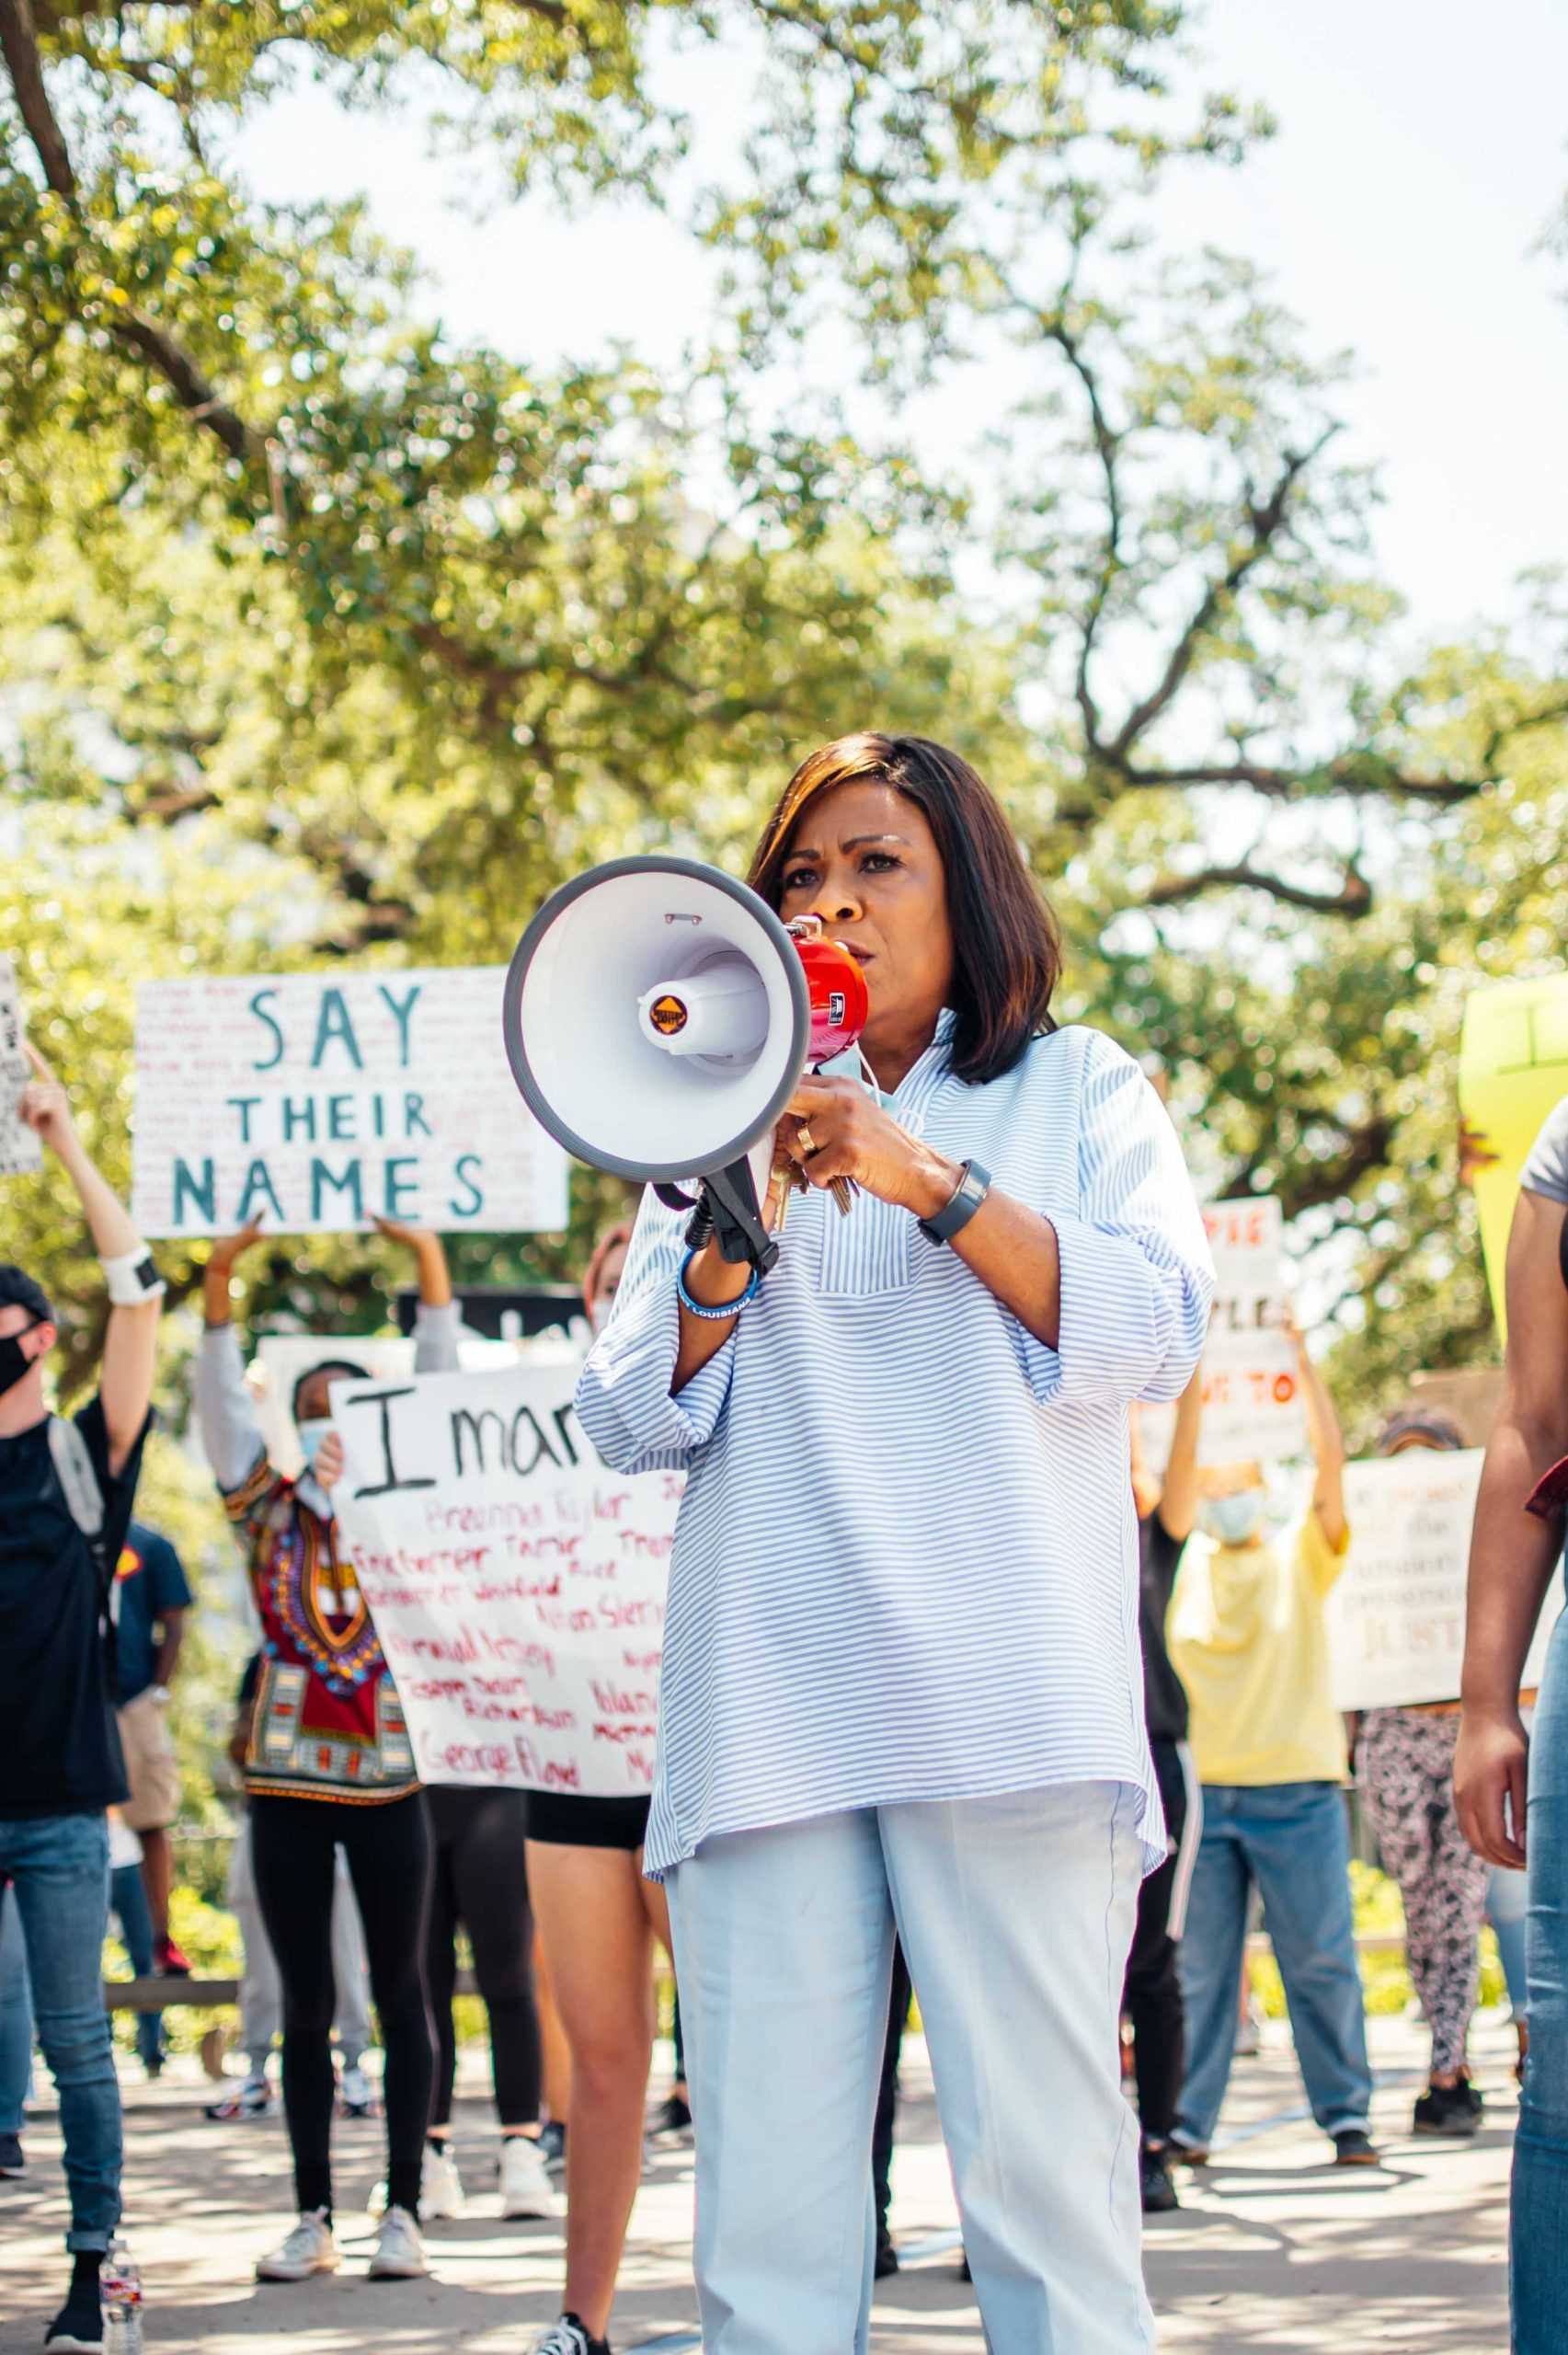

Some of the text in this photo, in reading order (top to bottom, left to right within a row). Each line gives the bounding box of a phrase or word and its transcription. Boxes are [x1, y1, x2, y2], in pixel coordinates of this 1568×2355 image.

[248, 984, 421, 1072] SAY
[226, 1092, 433, 1143] THEIR
[172, 1154, 485, 1226] NAMES
[692, 1297, 752, 1319] LOUISIANA
[346, 1385, 614, 1499] I mar
